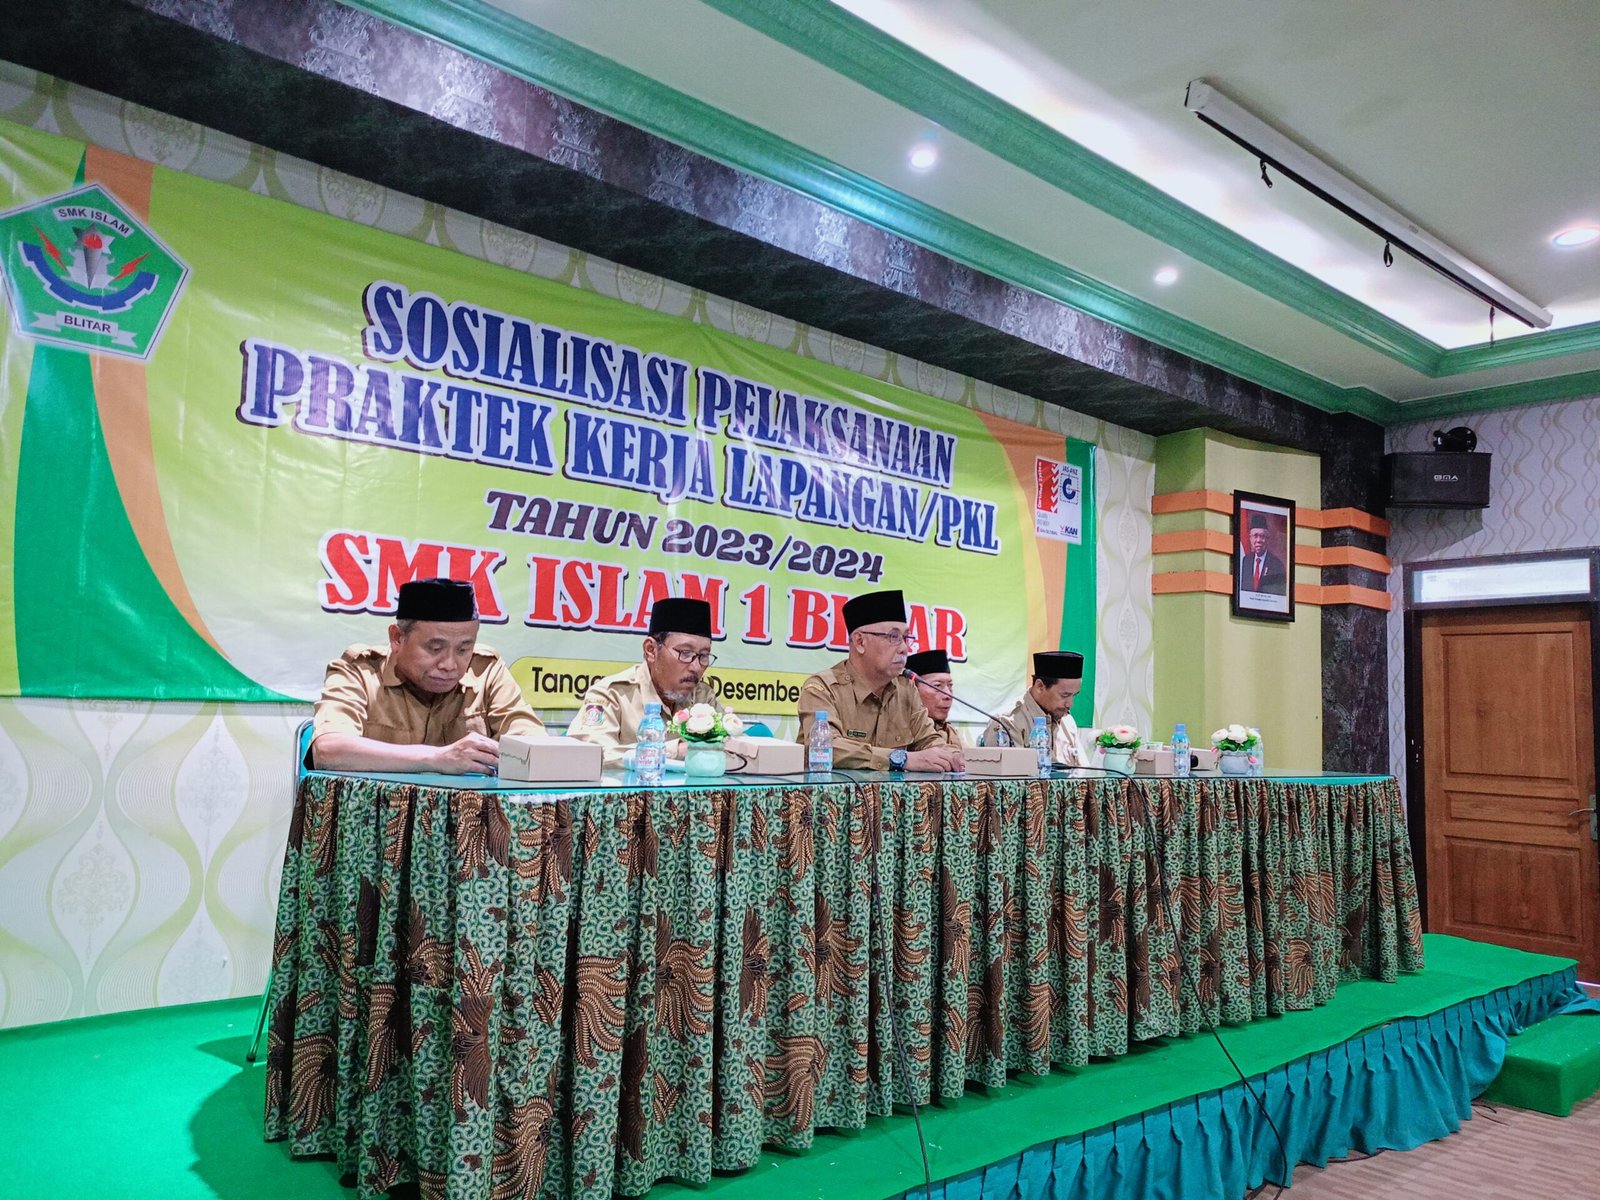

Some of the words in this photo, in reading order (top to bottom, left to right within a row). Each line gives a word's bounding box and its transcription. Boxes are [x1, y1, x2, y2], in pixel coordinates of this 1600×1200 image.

[58, 206, 88, 219] SMK
[90, 209, 131, 236] ISLAM
[63, 313, 112, 334] BLITAR
[371, 283, 689, 423] SOSIALISASI
[698, 367, 957, 487] PELAKSANAAN
[248, 341, 556, 471] PRAKTEK
[569, 410, 717, 501] KERJA
[724, 445, 1001, 552] LAPANGAN/PKL
[486, 490, 659, 549] TAHUN
[661, 518, 884, 583] 2023/2024
[323, 532, 504, 618] SMK
[743, 583, 771, 641] 1
[788, 588, 966, 659] BLAR
[708, 675, 803, 703] Desembe
